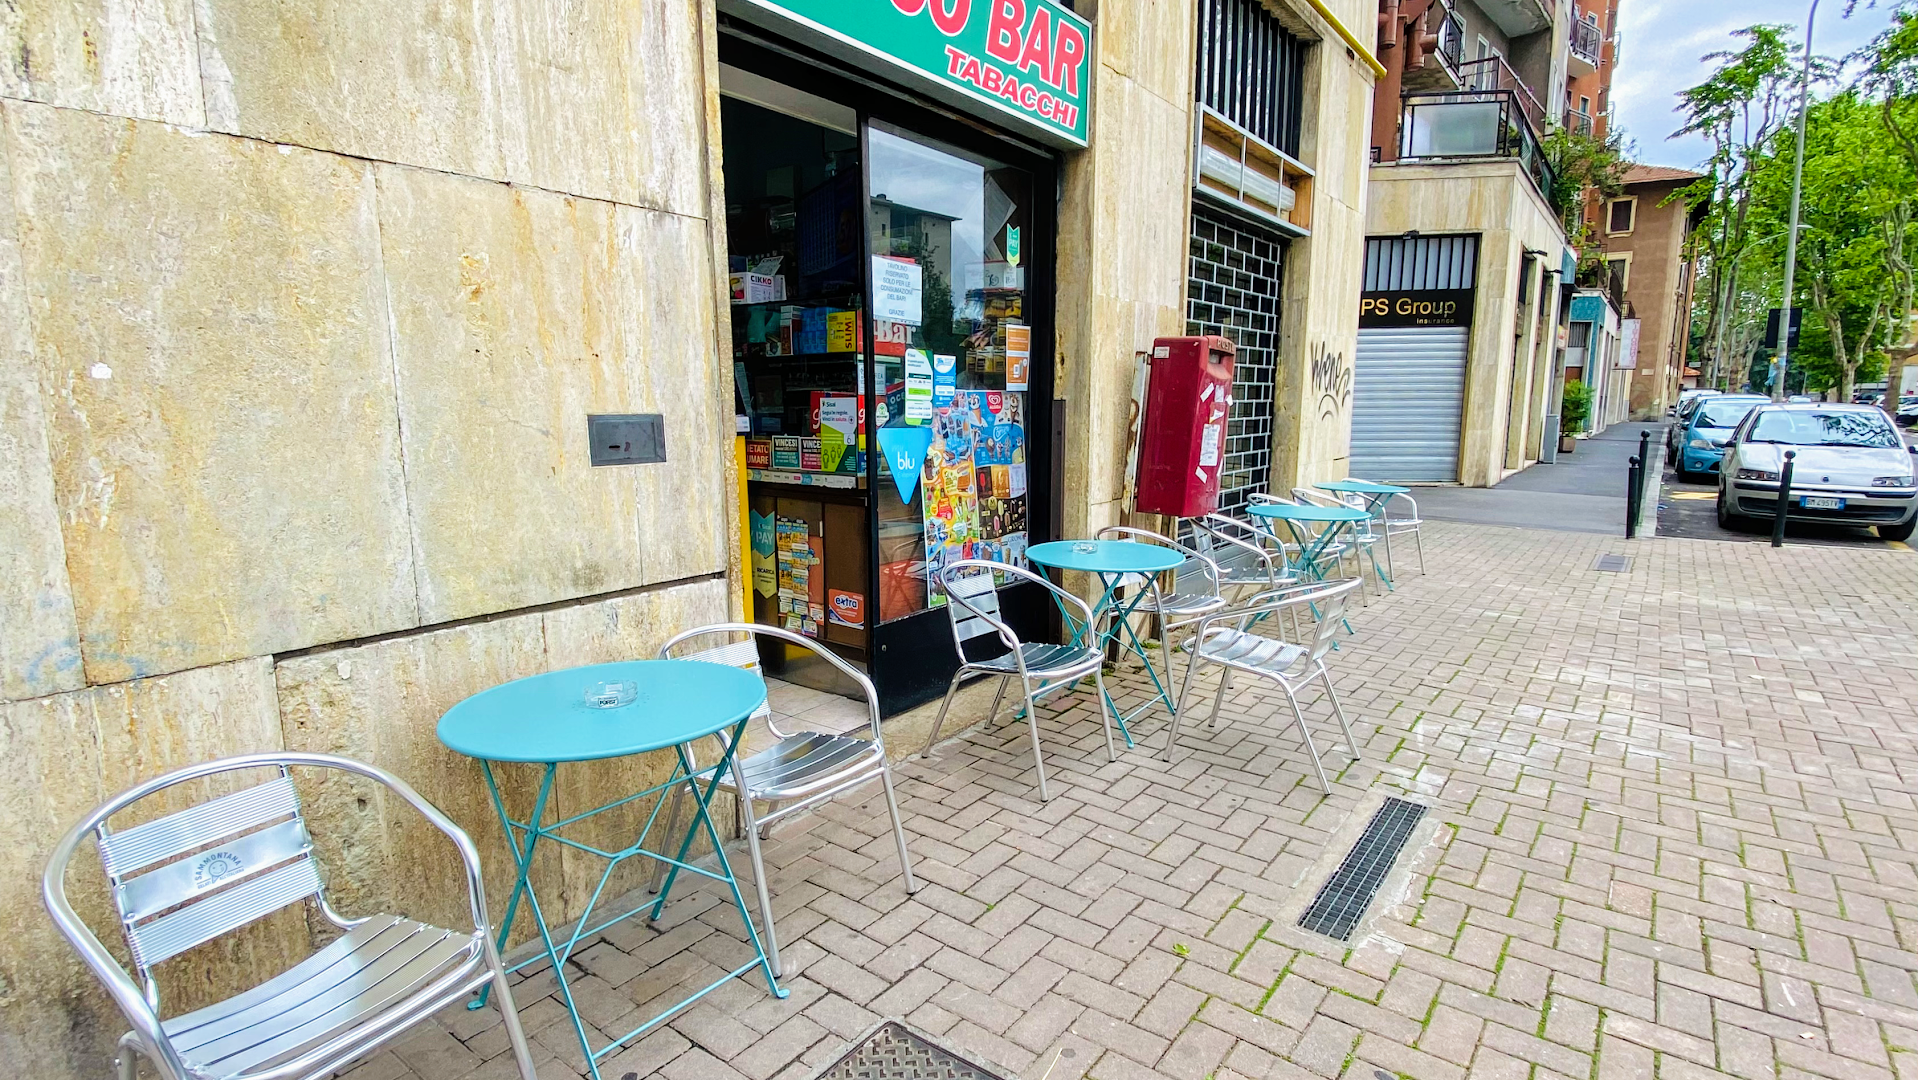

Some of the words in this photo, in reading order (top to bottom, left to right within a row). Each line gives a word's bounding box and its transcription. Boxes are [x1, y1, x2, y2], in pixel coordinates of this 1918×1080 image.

[985, 0, 1086, 99] BAR
[944, 44, 1080, 131] TABACCHI
[751, 275, 772, 285] CIKKO
[883, 277, 896, 285] SOLO
[888, 308, 905, 317] GRAZIE
[1360, 298, 1389, 316] PS
[1396, 297, 1456, 318] Group
[845, 321, 853, 349] SLIM
[746, 444, 769, 454] IETATO
[746, 455, 769, 464] UMARE
[898, 451, 915, 470] blu
[755, 531, 774, 545] PAY
[835, 597, 857, 608] extra
[195, 852, 241, 881] SAMMONTANA
